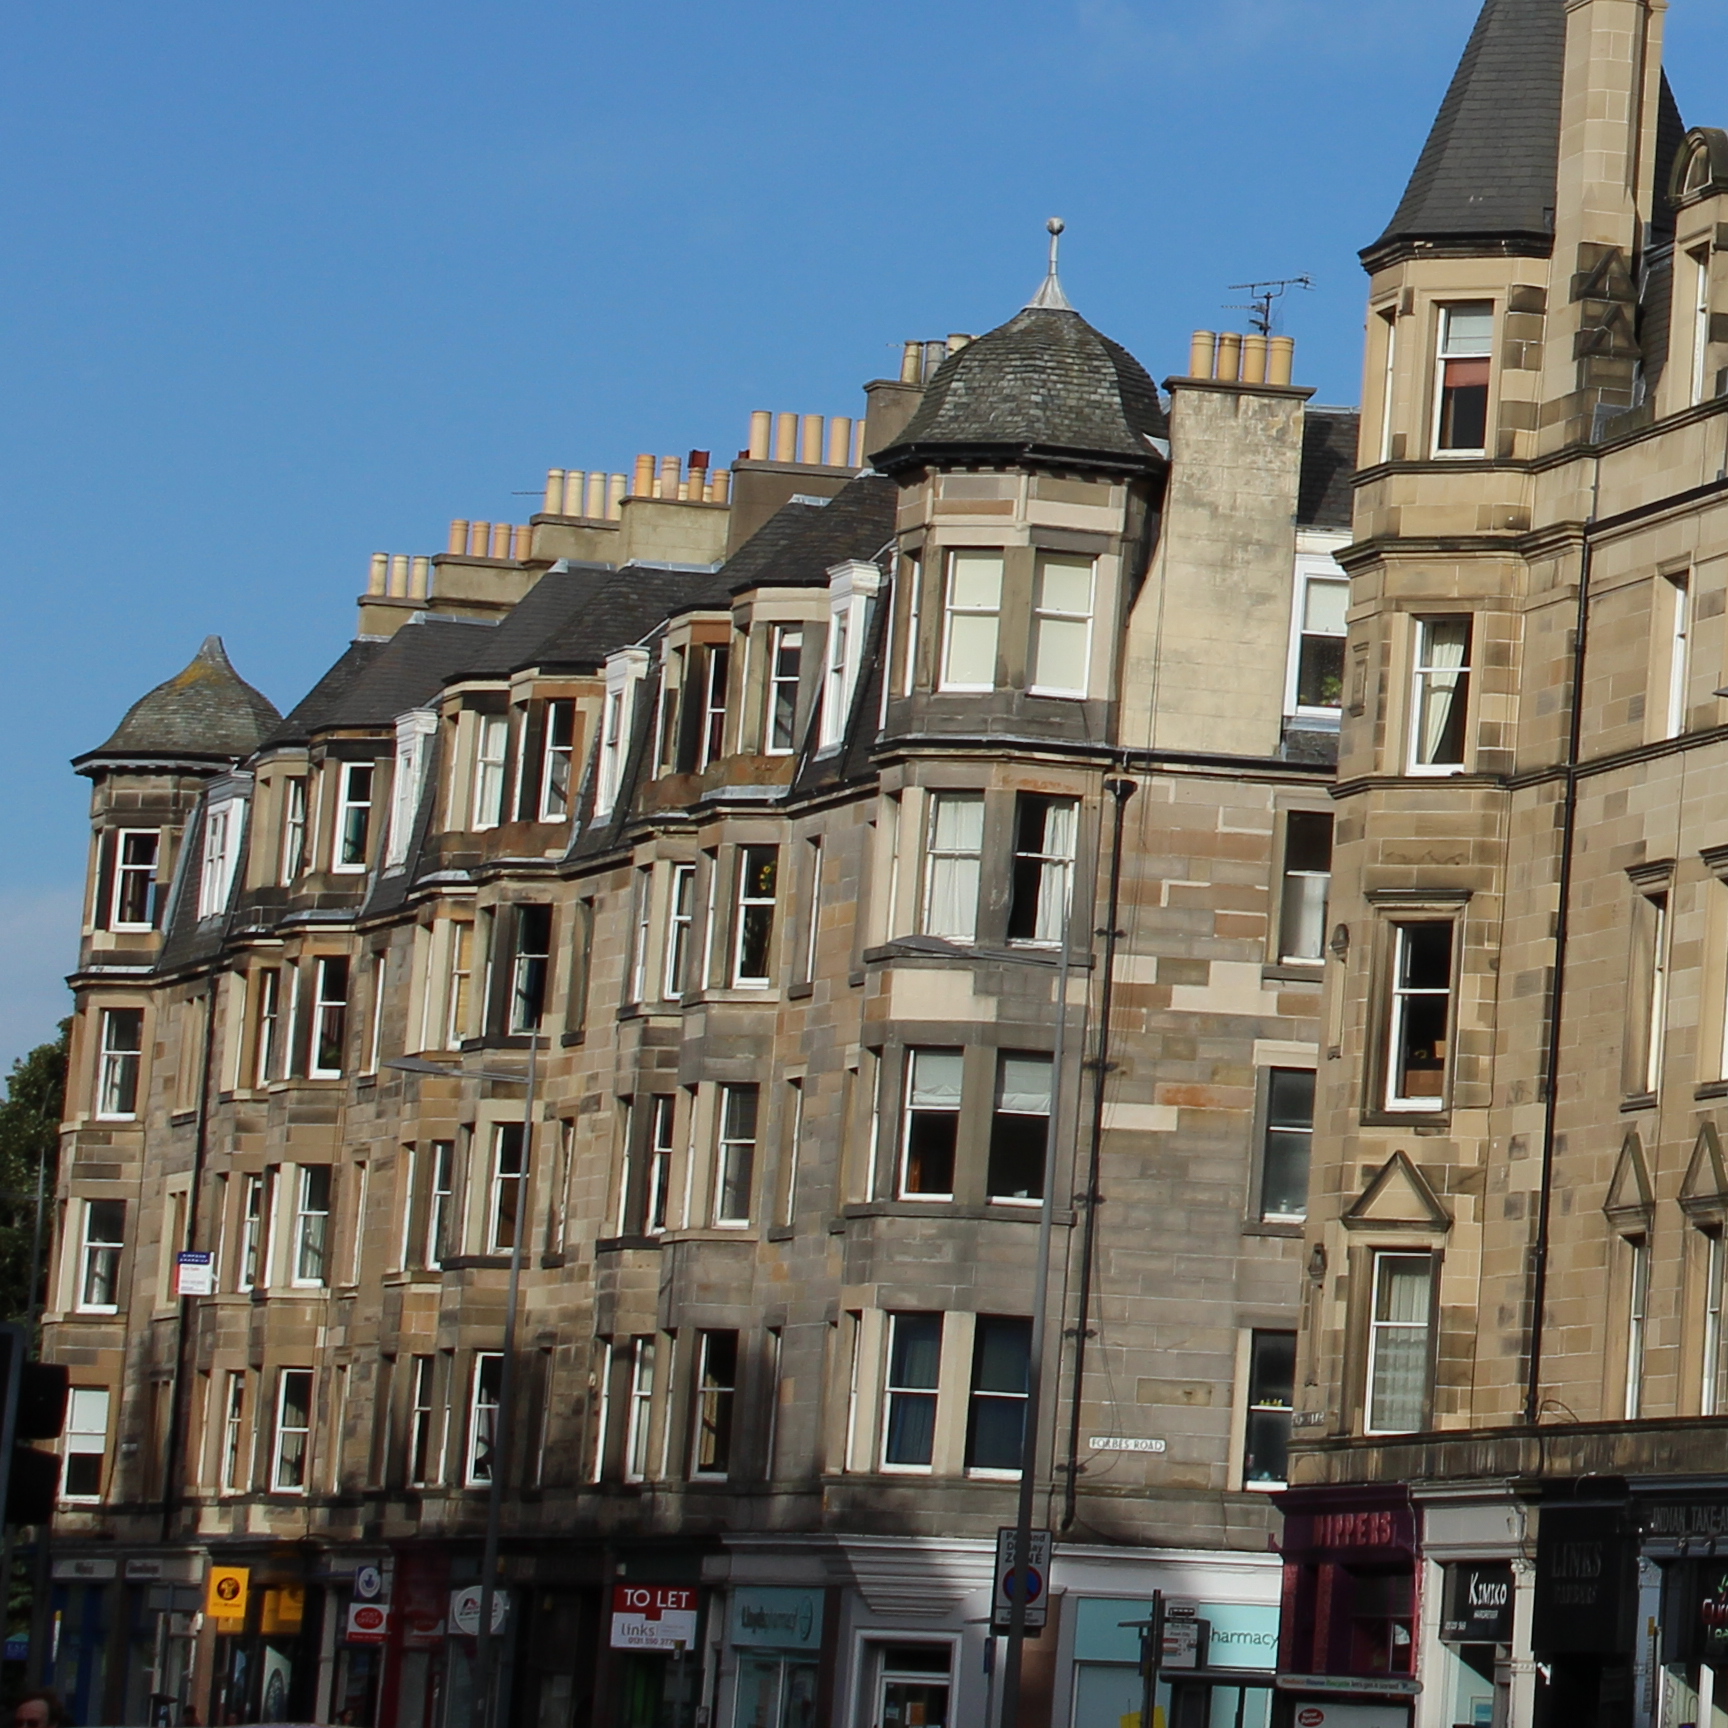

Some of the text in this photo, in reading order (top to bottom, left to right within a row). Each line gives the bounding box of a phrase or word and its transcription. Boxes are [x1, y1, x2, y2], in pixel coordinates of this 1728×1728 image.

[1092, 1437, 1163, 1451] FORBES ROAD
[1551, 1541, 1603, 1578] LINKS
[623, 1589, 690, 1609] TO LET
[621, 1623, 655, 1637] links
[1210, 1627, 1279, 1650] harmacy
